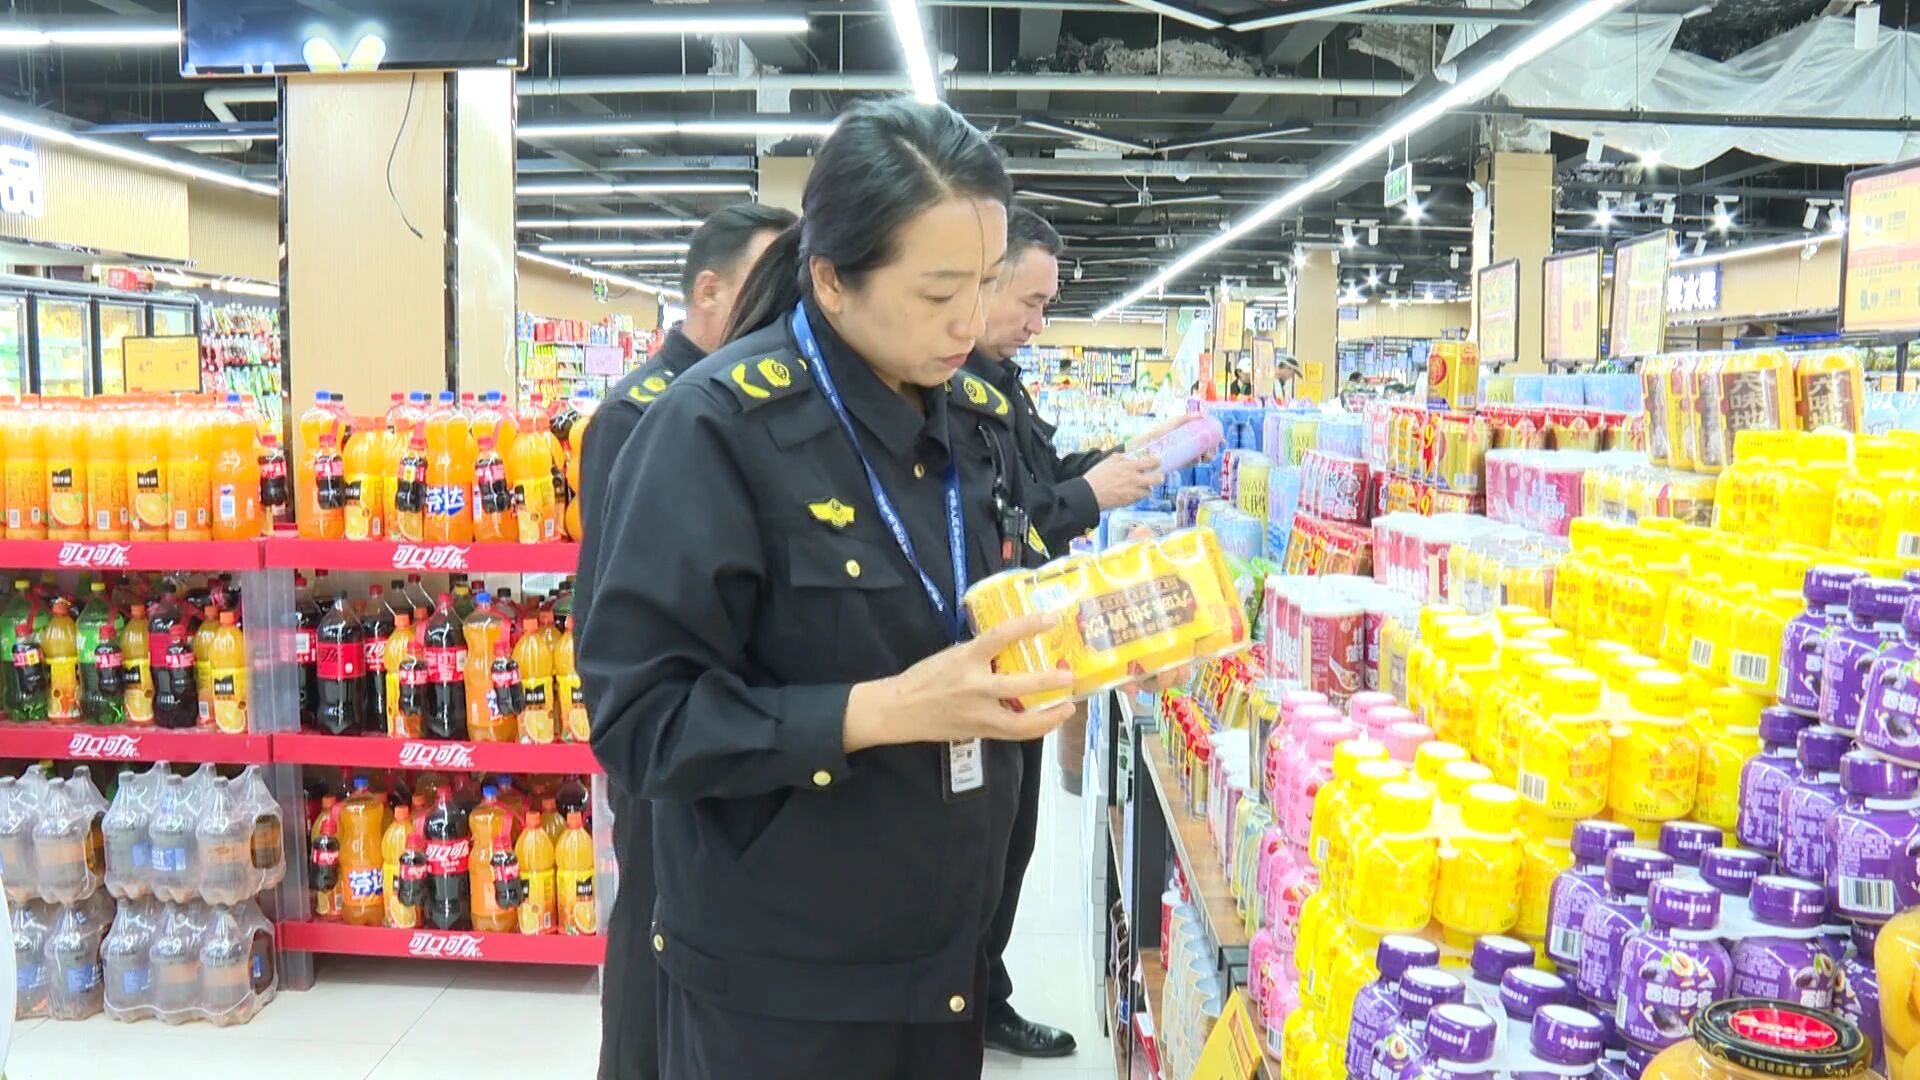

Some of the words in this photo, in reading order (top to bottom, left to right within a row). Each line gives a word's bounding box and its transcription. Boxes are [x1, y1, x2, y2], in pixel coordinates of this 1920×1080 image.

[426, 486, 466, 514] 芬达
[58, 542, 131, 567] 可口可乐
[392, 544, 472, 570] 可口可乐
[69, 733, 142, 758] 可口可乐
[399, 742, 476, 768] 可口可乐
[408, 932, 485, 958] 可口可乐
